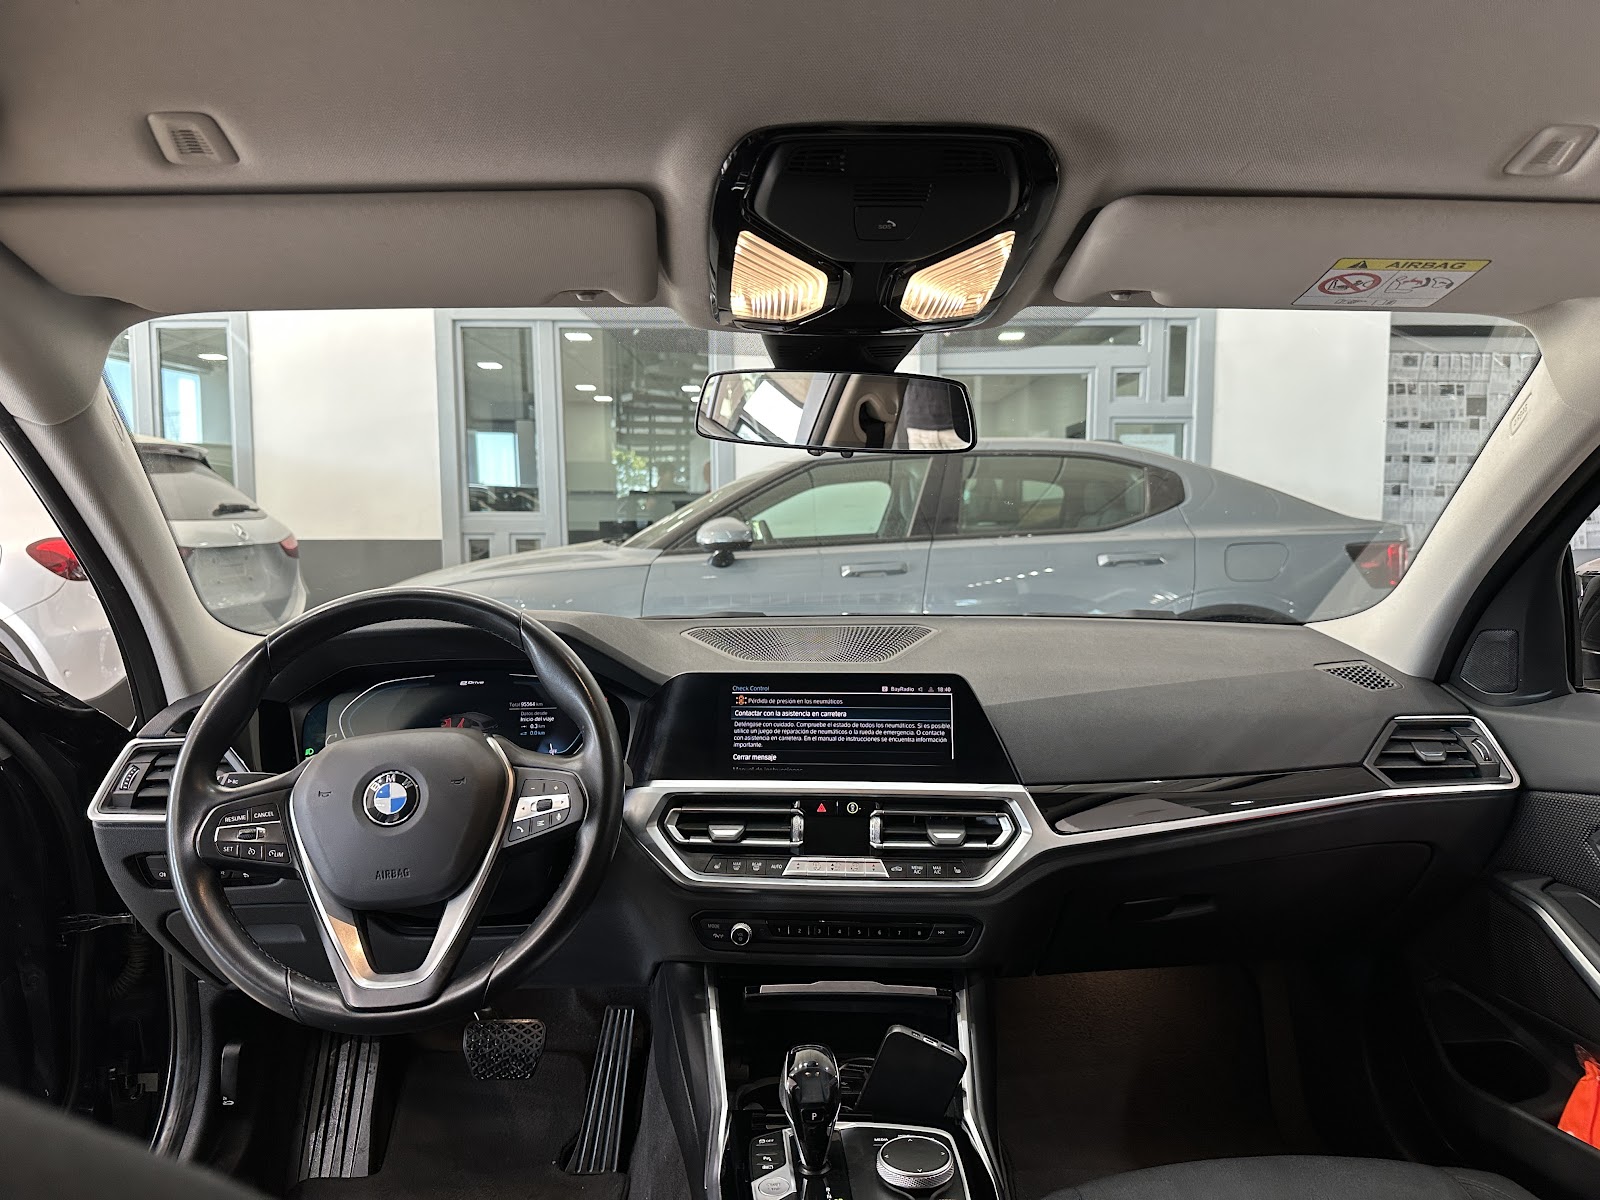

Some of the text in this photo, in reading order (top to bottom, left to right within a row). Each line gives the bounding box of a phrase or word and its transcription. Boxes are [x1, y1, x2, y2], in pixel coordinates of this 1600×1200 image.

[1385, 261, 1467, 270] AIRBAG
[776, 697, 796, 705] presión
[734, 709, 762, 717] Contactar
[775, 709, 781, 717] la
[781, 709, 811, 717] asistencia
[820, 710, 847, 718] carretera
[733, 720, 762, 728] Deténgase
[796, 721, 827, 729] Compruebe
[832, 721, 852, 729] estado
[781, 728, 810, 736] reparación
[882, 729, 916, 737] emergencia.
[732, 753, 777, 762] Cerrar mensaje
[369, 774, 414, 792] BMW
[224, 814, 247, 823] RESUME
[253, 811, 275, 819] CANCEL
[375, 867, 411, 881] AIRBAG
[811, 1112, 818, 1121] P
